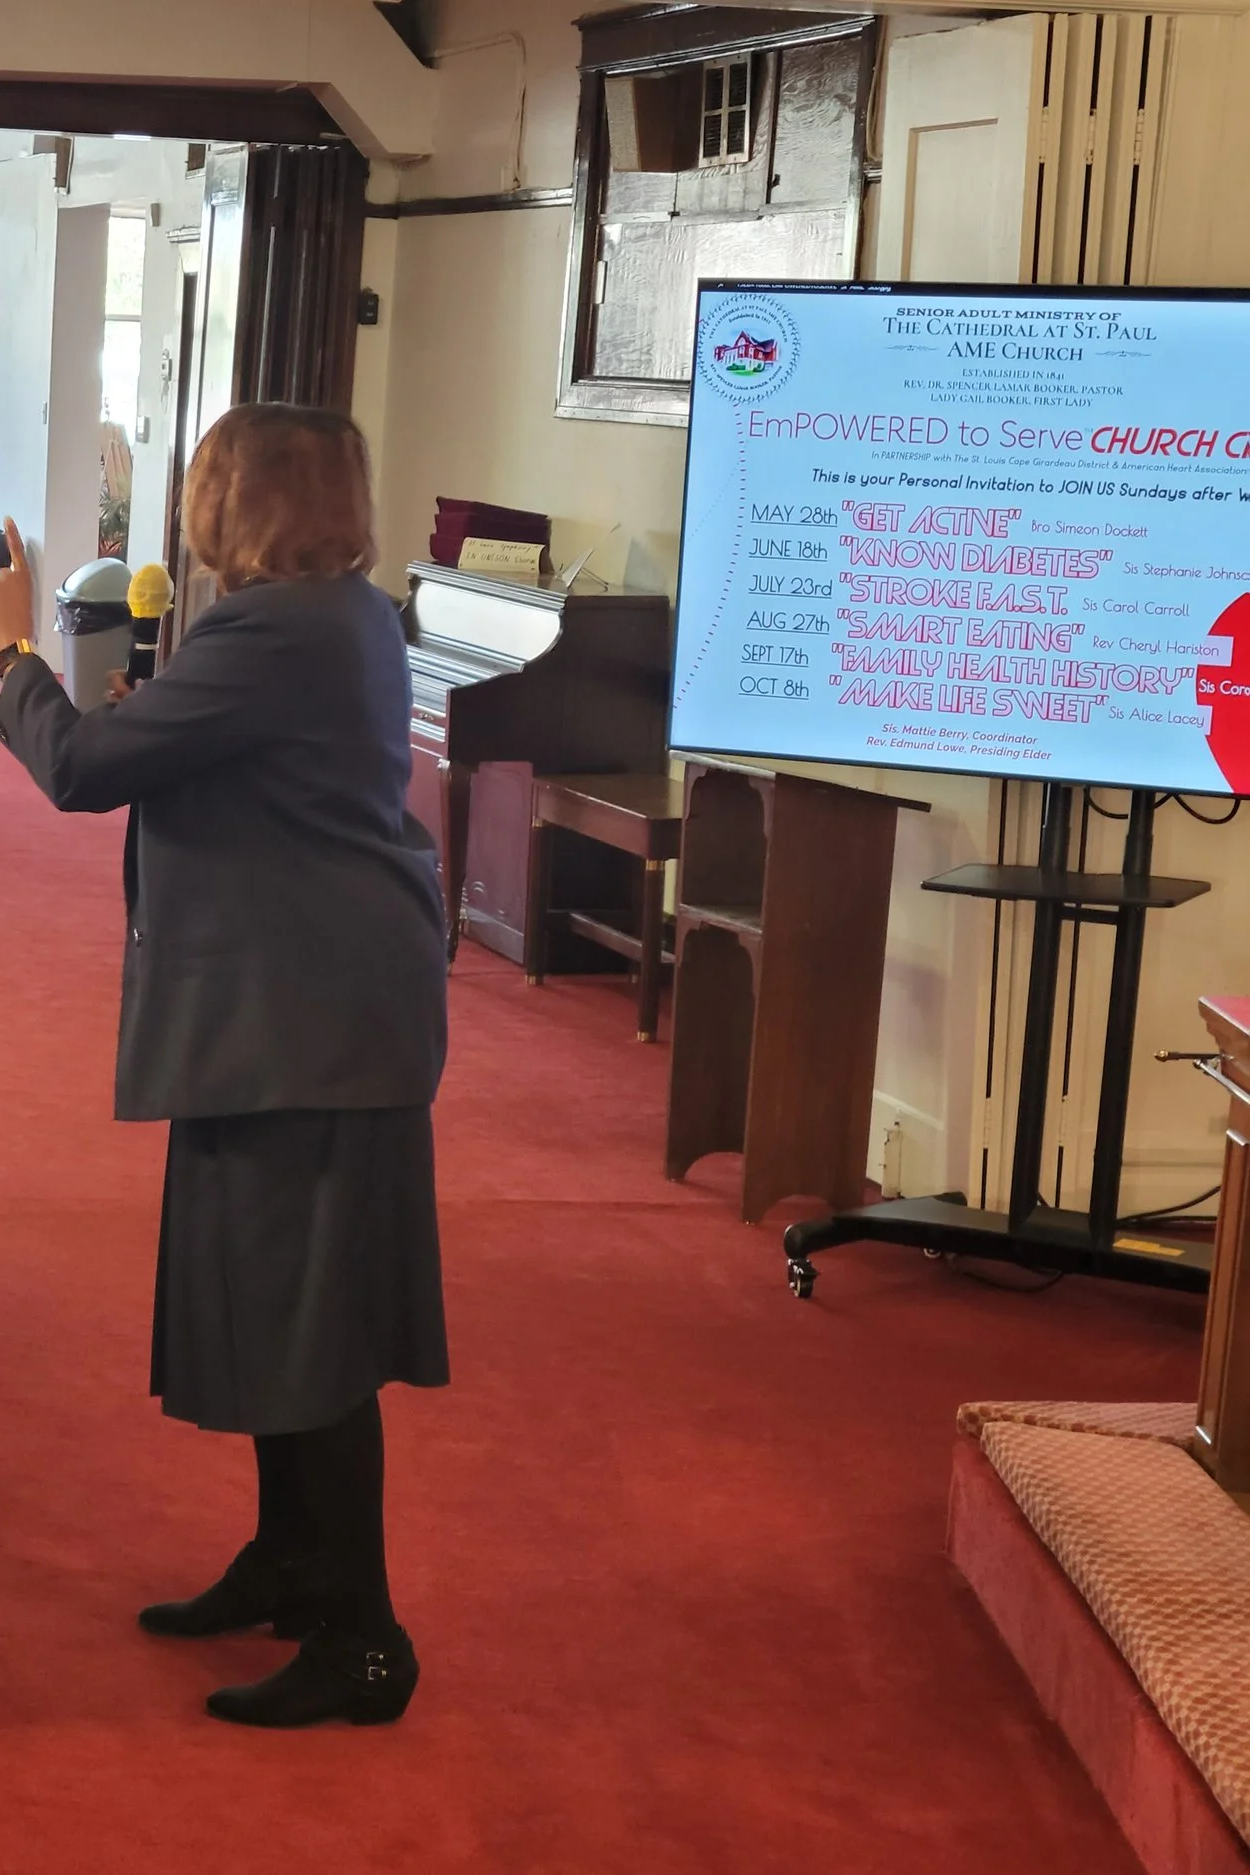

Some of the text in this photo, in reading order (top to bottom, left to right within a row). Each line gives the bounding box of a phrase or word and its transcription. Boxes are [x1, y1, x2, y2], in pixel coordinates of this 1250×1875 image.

[896, 307, 1122, 322] SENIOR ADULT MINISTRY OF
[1043, 324, 1068, 339] AT
[947, 341, 996, 359] AME
[962, 368, 1030, 379] ESTABLISHED
[1032, 370, 1044, 379] IN
[930, 393, 957, 402] LADY
[959, 394, 984, 404] GAIL
[1034, 396, 1063, 406] FIRST
[1065, 398, 1094, 408] LADY
[946, 381, 991, 391] SPENCER
[994, 382, 1031, 392] LAMAR
[1081, 385, 1124, 396] PASTOR
[749, 411, 949, 445] EmPOWERED
[958, 421, 989, 447] to
[999, 420, 1083, 451] Serve
[1091, 426, 1220, 458] CHURCH
[880, 451, 931, 461] PARTNERSHIP
[933, 454, 951, 462] with
[954, 454, 969, 463] The
[983, 456, 1006, 465] Louis
[1008, 456, 1030, 467] Cape
[1032, 457, 1076, 469] Girardeau
[1077, 459, 1110, 470] District
[1112, 461, 1119, 470] &
[1121, 461, 1166, 472] American
[1167, 463, 1192, 473] Heart
[1194, 464, 1247, 475] Association
[812, 468, 840, 484] This
[843, 471, 856, 484] is
[860, 474, 895, 488] your
[898, 472, 963, 490] Personal
[965, 475, 1035, 493] Invitation
[1039, 478, 1054, 494] to
[1058, 479, 1094, 496] JOIN
[1097, 480, 1115, 496] US
[1119, 481, 1187, 502] Sundays
[1192, 486, 1233, 501] after
[751, 503, 794, 522] MAY
[800, 506, 838, 526] 28th
[1031, 519, 1050, 533] Bro
[1056, 521, 1100, 536] Simeon
[1105, 523, 1149, 538] Dockett
[748, 538, 792, 557] JUNE
[797, 540, 828, 560] 18th
[1123, 561, 1139, 575] Sis
[1143, 562, 1202, 580] Stephanie
[748, 574, 785, 593] JULY
[791, 577, 832, 597] 23rd
[1082, 598, 1098, 612] Sis
[1103, 598, 1139, 614] Carol
[1145, 601, 1190, 617] Carroll
[746, 610, 786, 630] AUG
[793, 613, 830, 632] 27th
[1093, 636, 1113, 650] Rev
[1119, 637, 1161, 655] Cheryl
[1166, 640, 1220, 657] Hariston
[741, 643, 774, 662] SEPT
[780, 646, 809, 665] 17th
[947, 651, 1046, 686] HEALTH
[1199, 678, 1216, 694] Sis
[739, 675, 778, 695] OCT
[783, 679, 809, 697] 8th
[938, 684, 987, 715] LIFE
[1108, 706, 1125, 720] Sis
[1129, 707, 1163, 723] Alice
[1167, 708, 1205, 728] Lacey
[902, 725, 937, 737] Mattie
[972, 730, 1038, 745] Coordinator
[890, 738, 934, 751] Edmund
[970, 744, 1020, 760] Presiding
[1022, 749, 1053, 761] Elder
